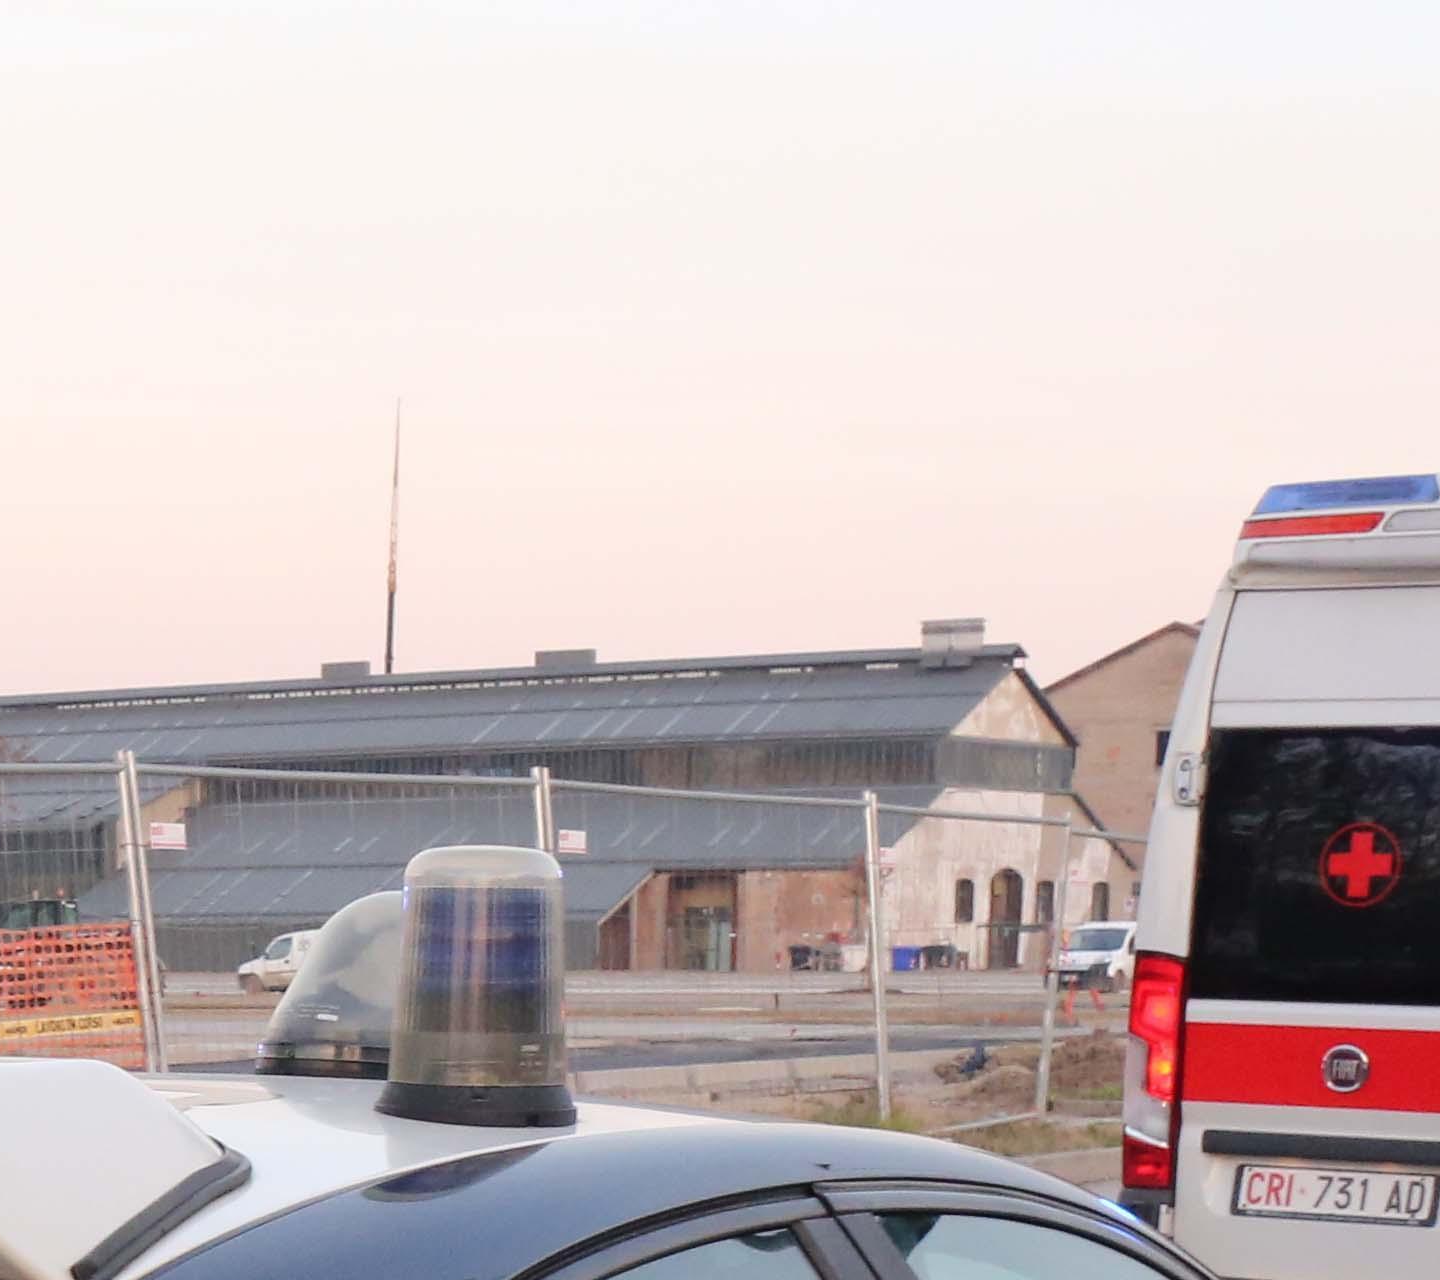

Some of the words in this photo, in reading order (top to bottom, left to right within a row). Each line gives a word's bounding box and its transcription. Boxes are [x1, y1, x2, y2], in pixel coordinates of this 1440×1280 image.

[1332, 1058, 1361, 1080] FIAT
[1247, 1171, 1294, 1207] CRI
[1313, 1176, 1369, 1211] 731
[1384, 1179, 1427, 1216] AD
